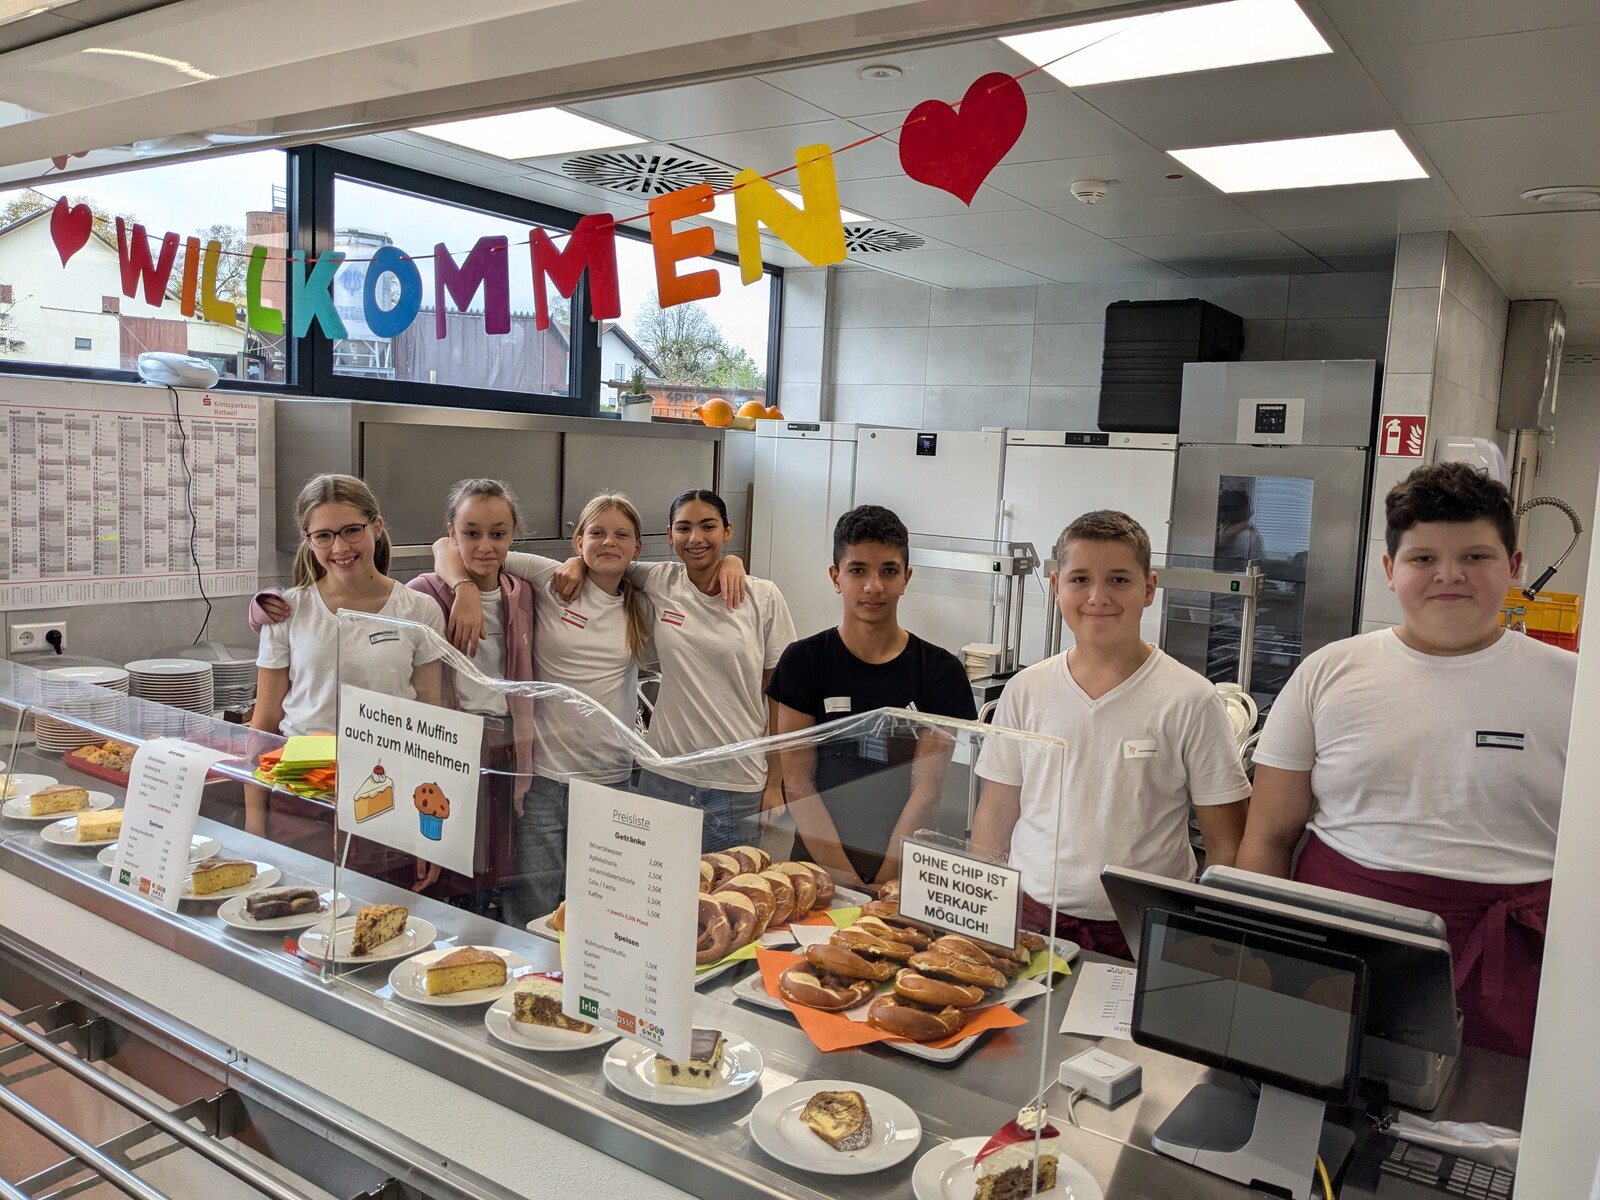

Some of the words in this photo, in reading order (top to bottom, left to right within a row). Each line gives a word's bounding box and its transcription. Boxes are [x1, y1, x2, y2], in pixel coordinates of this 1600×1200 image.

[116, 143, 847, 340] WILLKOMMEN
[214, 401, 256, 410] Kreissparkasse
[360, 703, 402, 727] Kuchen
[406, 718, 413, 732] &
[417, 720, 458, 744] Muffins
[345, 726, 373, 744] auch
[377, 736, 400, 752] zum
[404, 740, 470, 774] Mitnehmen
[613, 809, 650, 828] Preisliste
[615, 832, 646, 846] Getränke
[589, 842, 623, 856] Mineralwasser
[649, 859, 663, 868] 2,00€
[589, 854, 617, 868] Apfelschorle
[648, 872, 662, 881] 2,50€
[588, 866, 635, 886] Johannisbeerschorle
[647, 884, 662, 894] 2,50€
[912, 852, 948, 871] OHNE
[952, 863, 983, 880] CHIP
[987, 873, 1007, 887] IST
[588, 878, 599, 886] Cola
[603, 882, 616, 892] Fanta
[647, 897, 661, 906] 2,50€
[920, 870, 948, 888] KEIN
[953, 880, 998, 901] KIOSK-
[588, 890, 603, 900] Kaffee
[647, 910, 660, 919] 1,50€
[927, 889, 987, 915] VERKAUF
[925, 905, 988, 934] MÖGLICH!
[614, 932, 639, 948] Speisen
[584, 950, 601, 960] Kuchen
[645, 973, 658, 982] 2,00€
[584, 961, 596, 970] Torte
[645, 984, 657, 994] 2,50€
[645, 962, 658, 971] 1,50€
[645, 996, 657, 1005] 1,50€
[642, 1028, 661, 1042] GWRS
